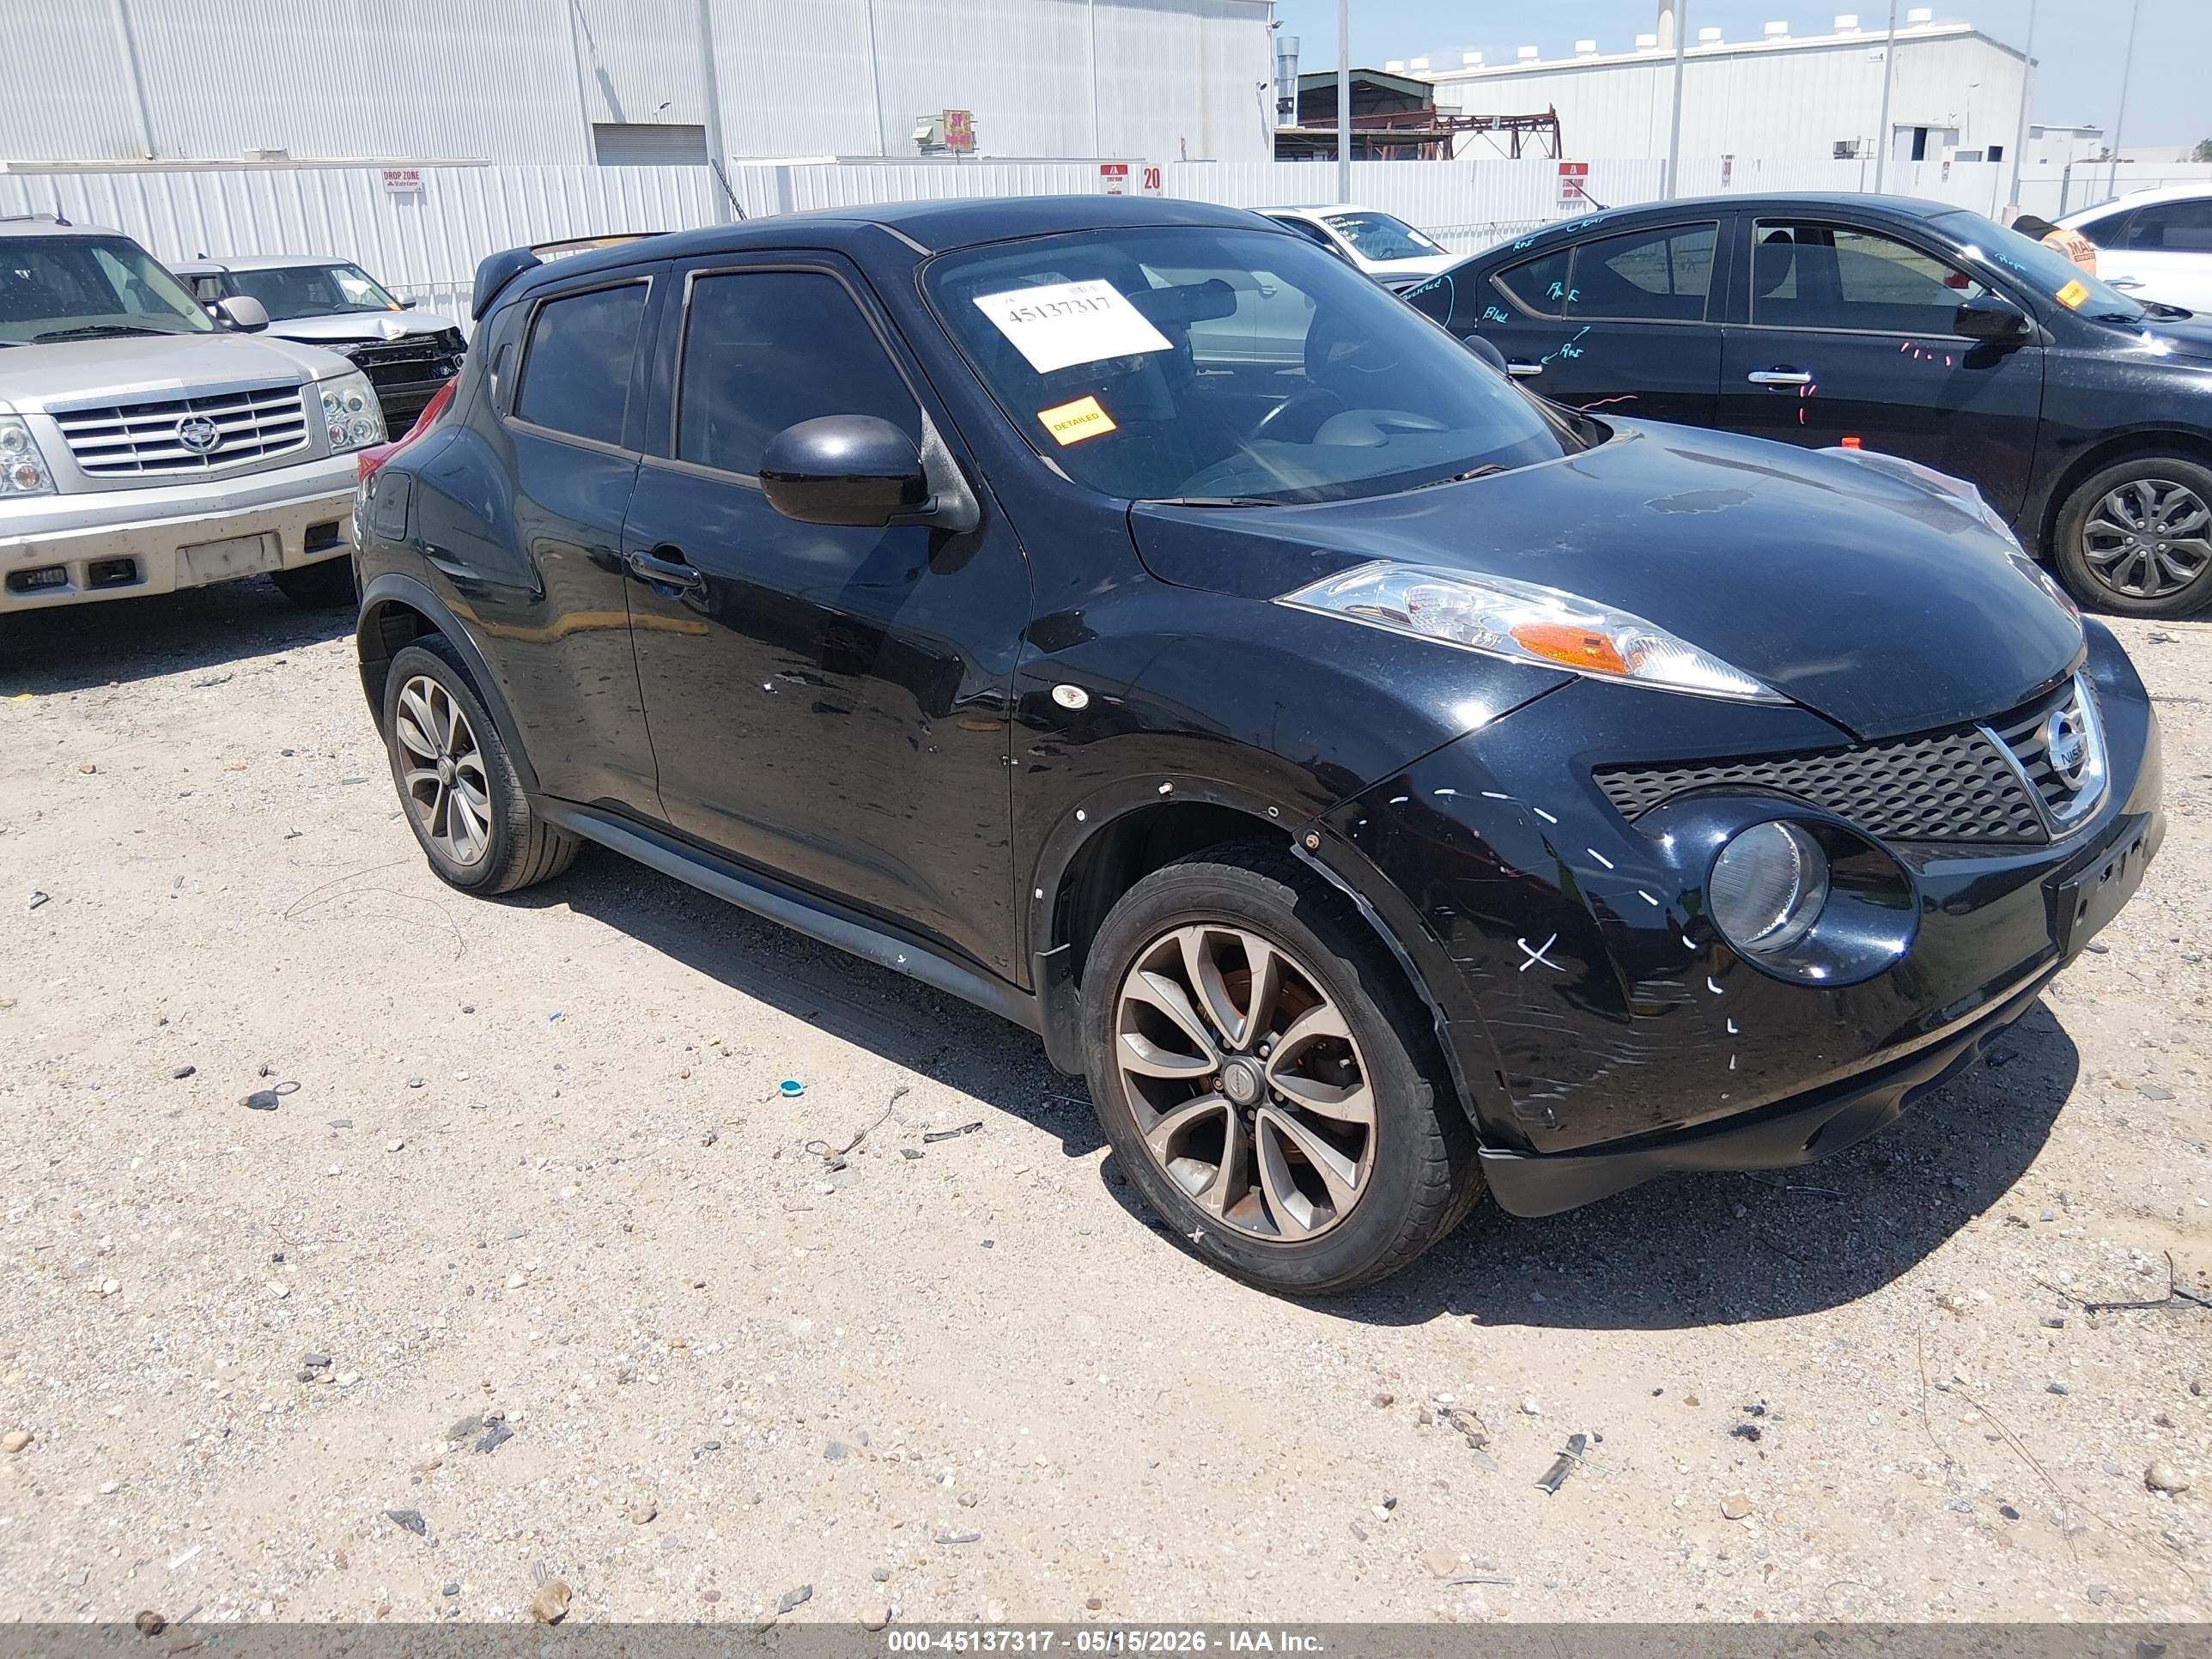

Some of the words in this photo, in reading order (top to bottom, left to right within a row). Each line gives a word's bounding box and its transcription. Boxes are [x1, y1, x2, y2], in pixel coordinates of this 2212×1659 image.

[384, 171, 402, 180] DROP
[403, 171, 420, 180] ZONE
[1144, 167, 1160, 189] 20
[1009, 296, 1111, 323] 45137317
[1053, 412, 1100, 432] DETAILED
